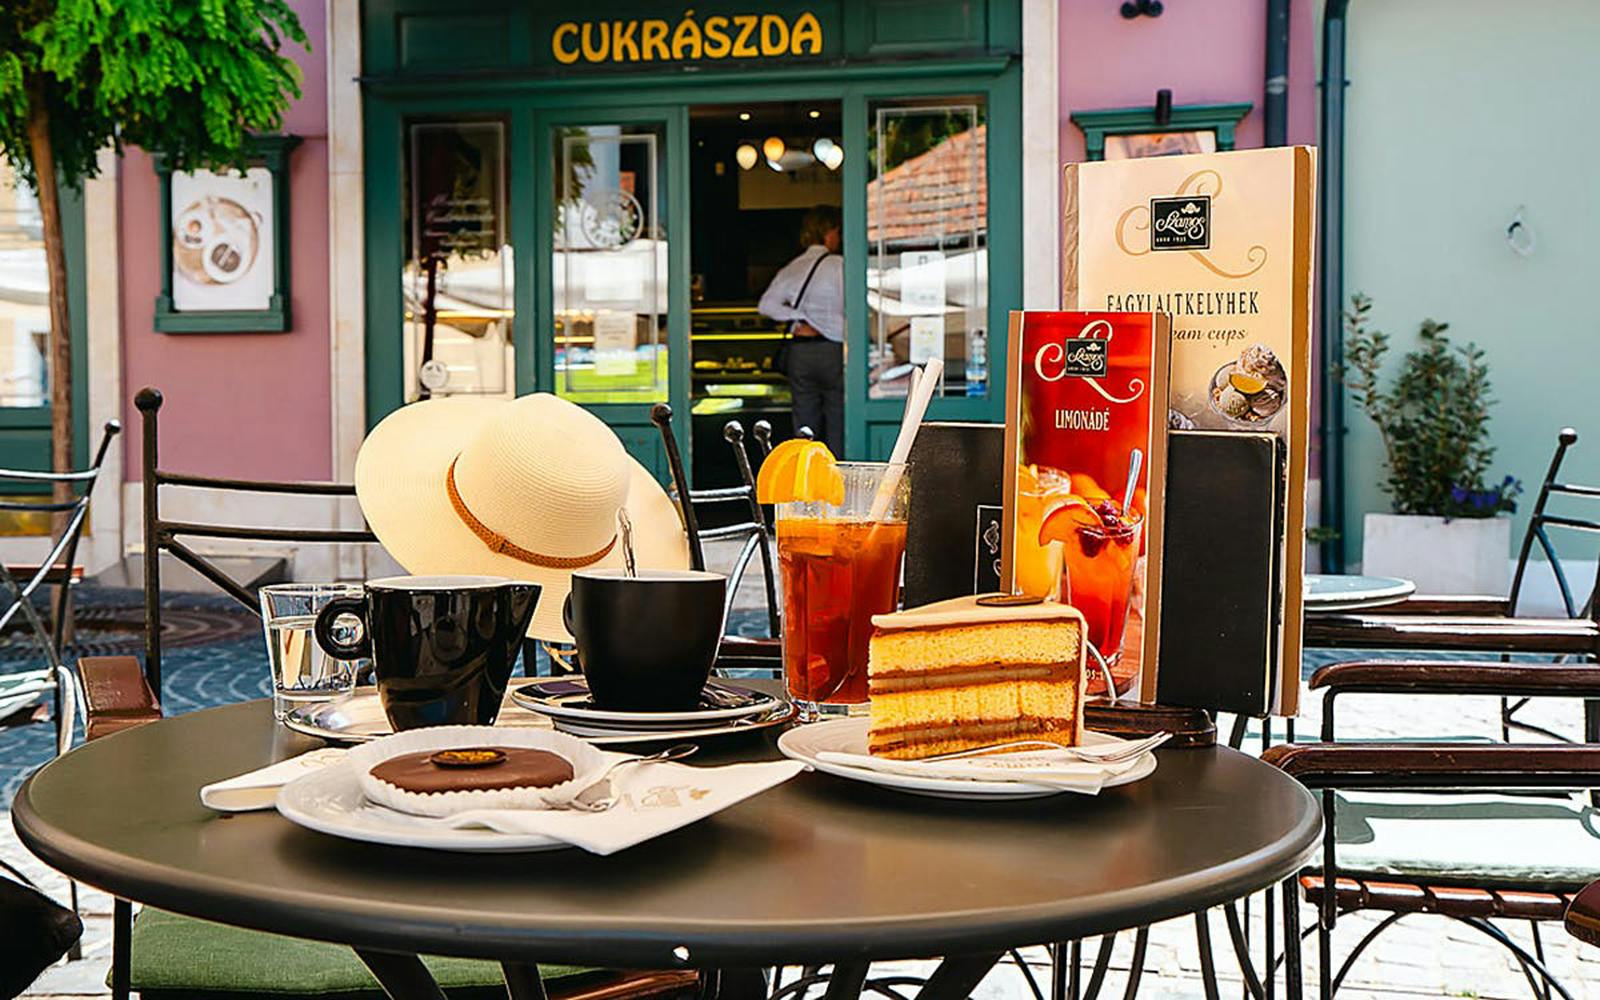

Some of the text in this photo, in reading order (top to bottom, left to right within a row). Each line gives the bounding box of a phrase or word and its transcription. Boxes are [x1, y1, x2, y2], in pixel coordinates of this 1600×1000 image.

[552, 9, 823, 64] CUKRÁSZDA
[1207, 329, 1246, 346] cups
[1055, 406, 1110, 431] LIMONÁDÉ
